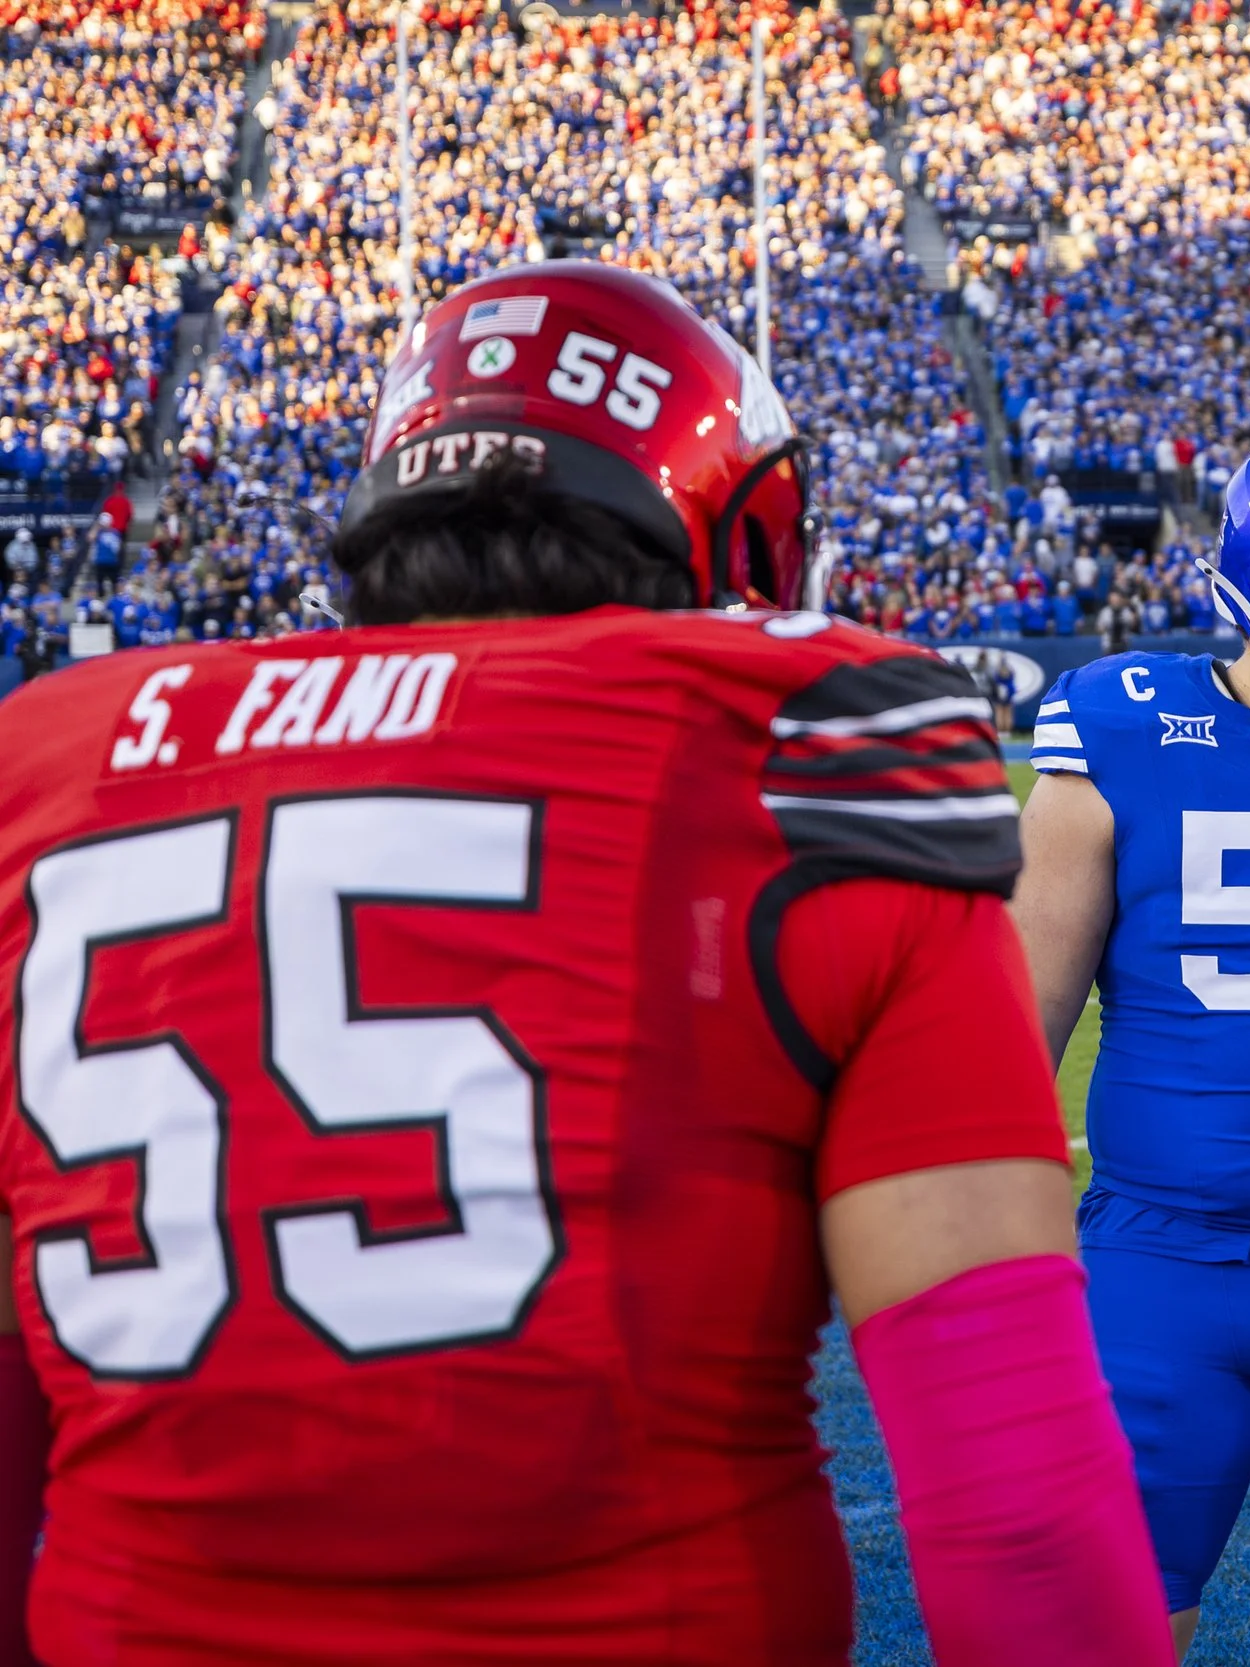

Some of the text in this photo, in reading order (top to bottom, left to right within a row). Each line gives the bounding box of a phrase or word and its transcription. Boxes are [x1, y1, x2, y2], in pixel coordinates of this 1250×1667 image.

[546, 330, 673, 431] 55
[111, 653, 458, 771] S. FANO
[1121, 667, 1155, 701] C
[1163, 715, 1214, 743] XII
[15, 787, 566, 1382] 55
